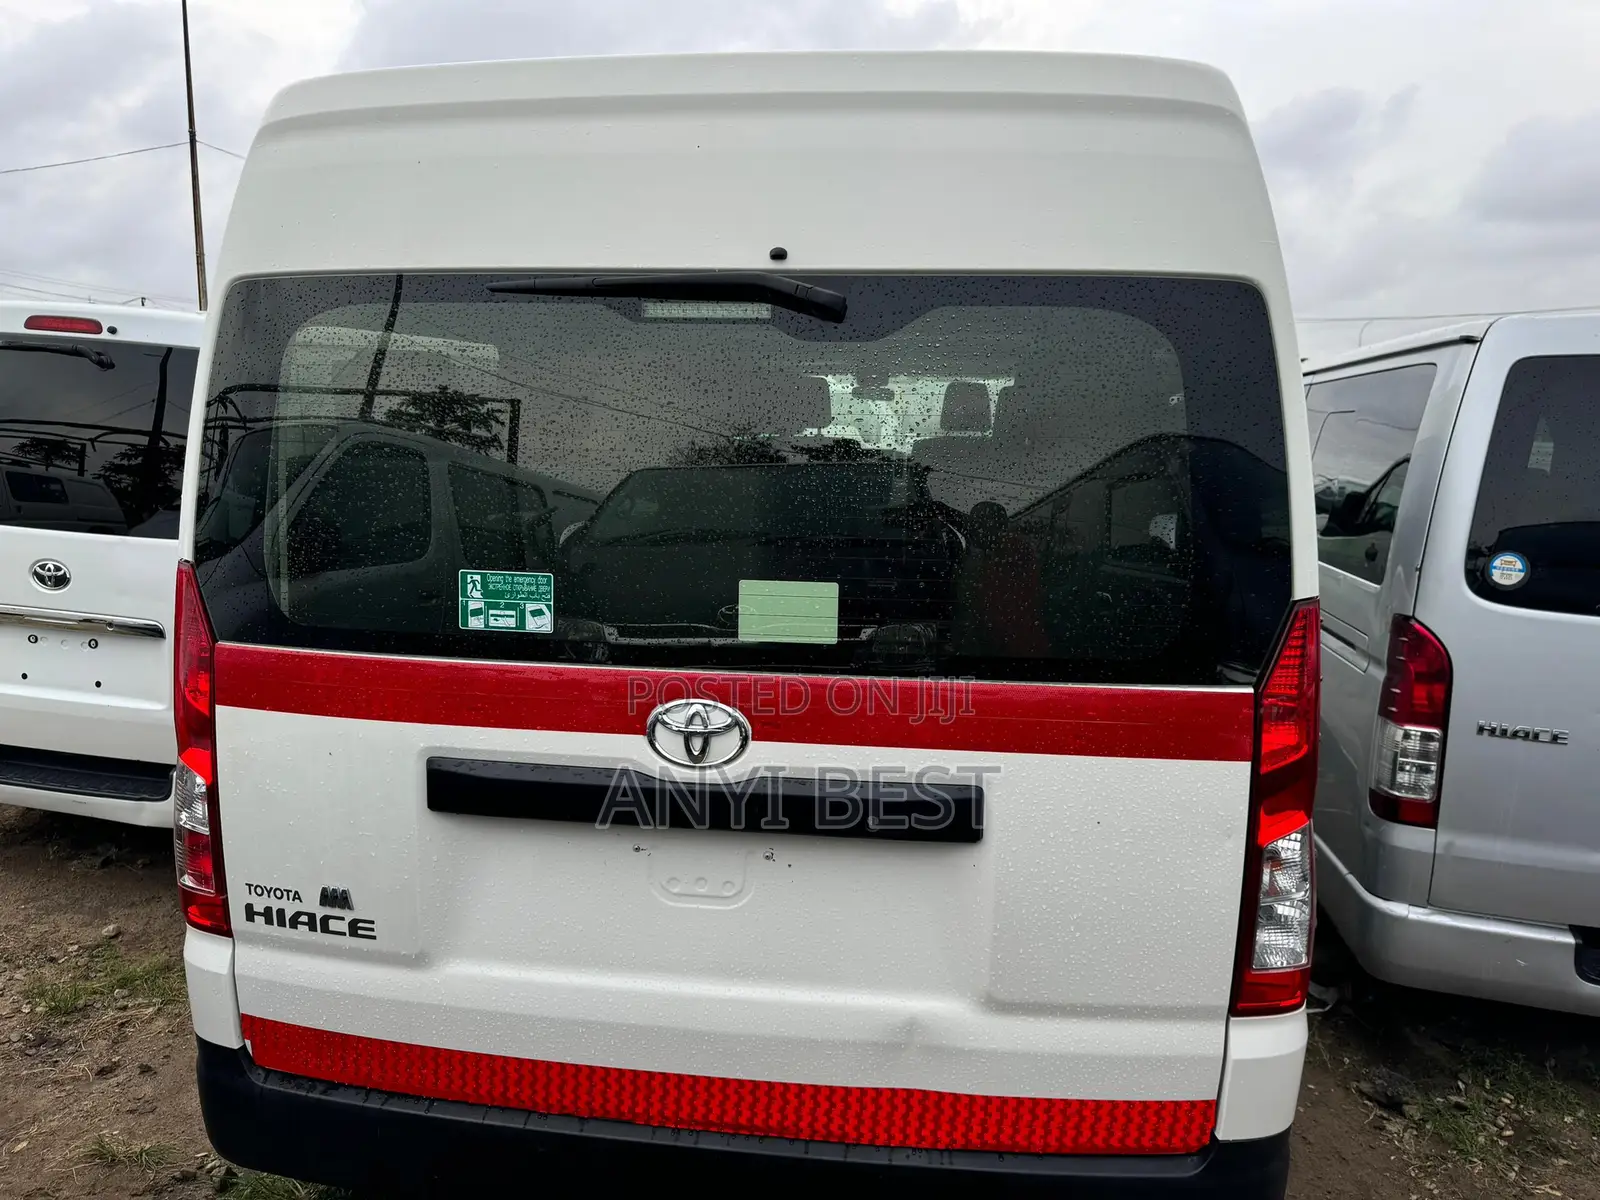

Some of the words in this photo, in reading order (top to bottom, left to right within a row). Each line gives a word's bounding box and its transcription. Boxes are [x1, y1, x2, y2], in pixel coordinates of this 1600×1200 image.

[486, 573, 504, 585] Opening
[513, 575, 536, 585] emergency
[538, 576, 548, 584] door
[1476, 720, 1569, 745] HIACE
[245, 882, 303, 903] TOYOTA
[245, 902, 377, 941] HIACE
